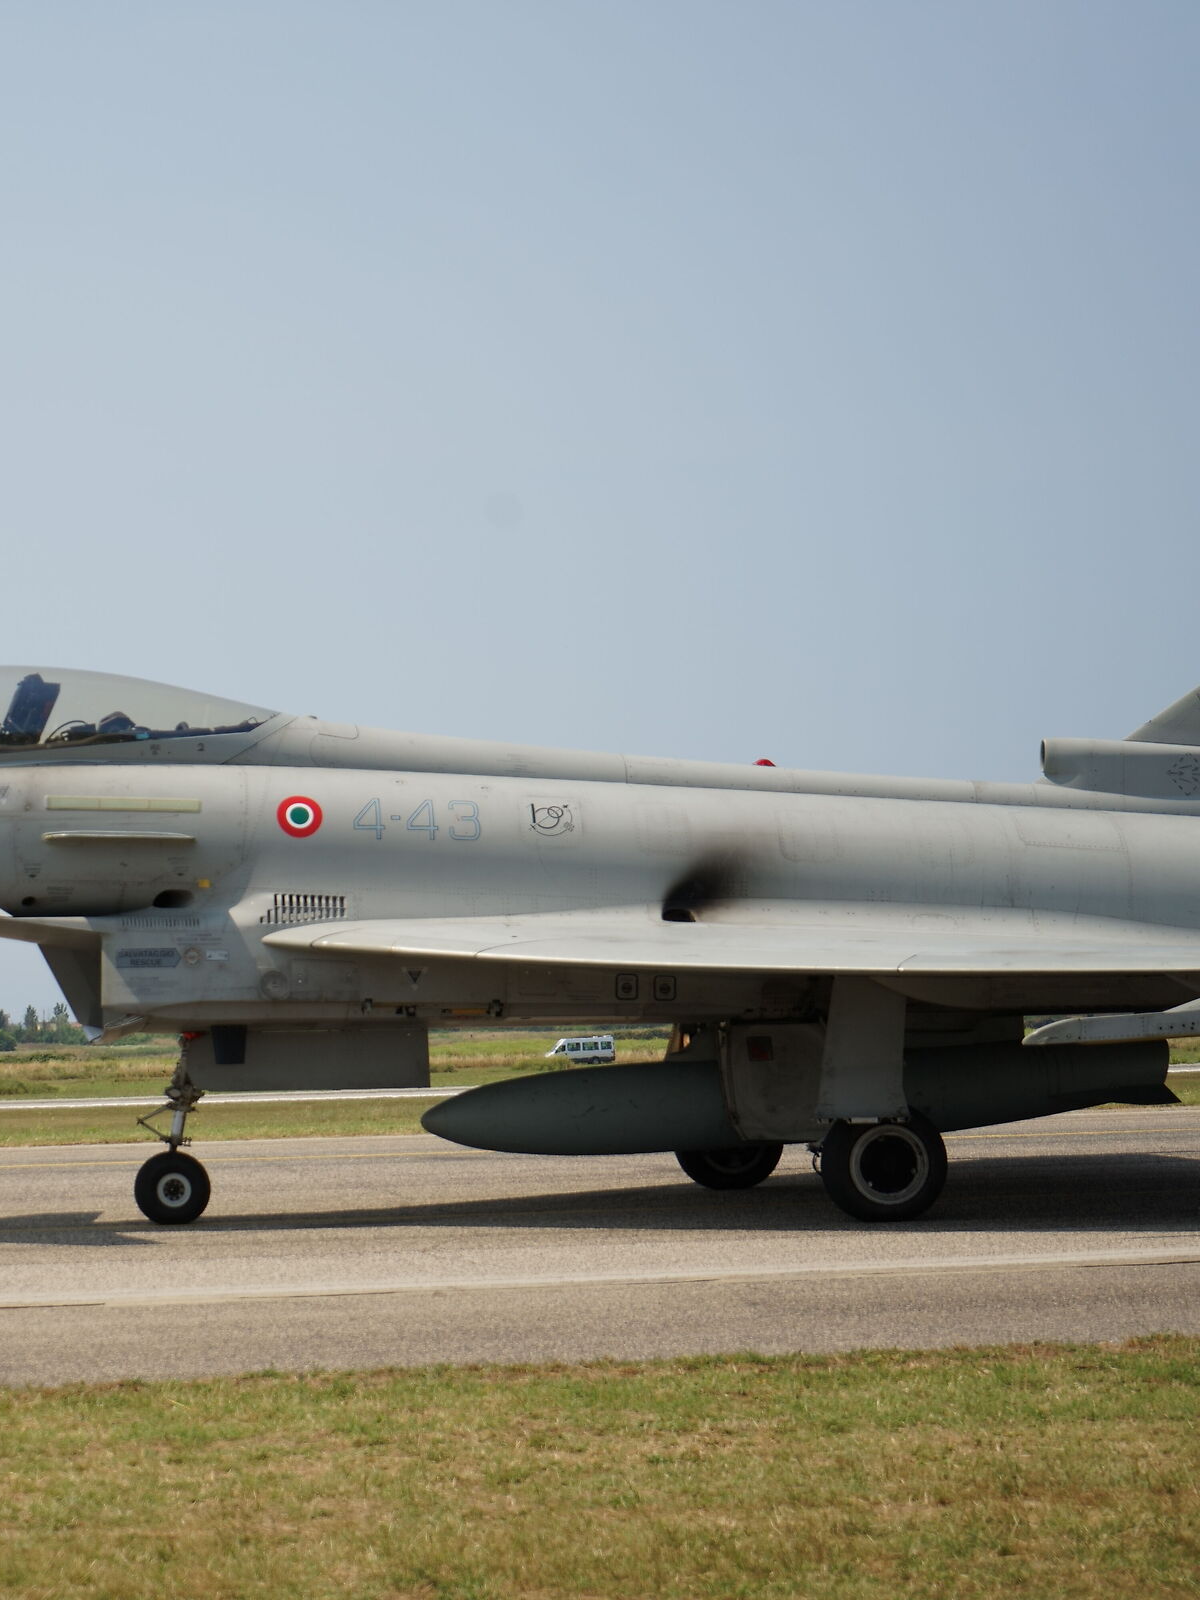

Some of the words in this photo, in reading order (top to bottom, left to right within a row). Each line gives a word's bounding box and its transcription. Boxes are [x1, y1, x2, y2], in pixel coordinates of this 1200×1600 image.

[352, 797, 482, 841] 4-43
[118, 949, 175, 958] SALVATAGGIO
[129, 958, 162, 966] RESCUE
